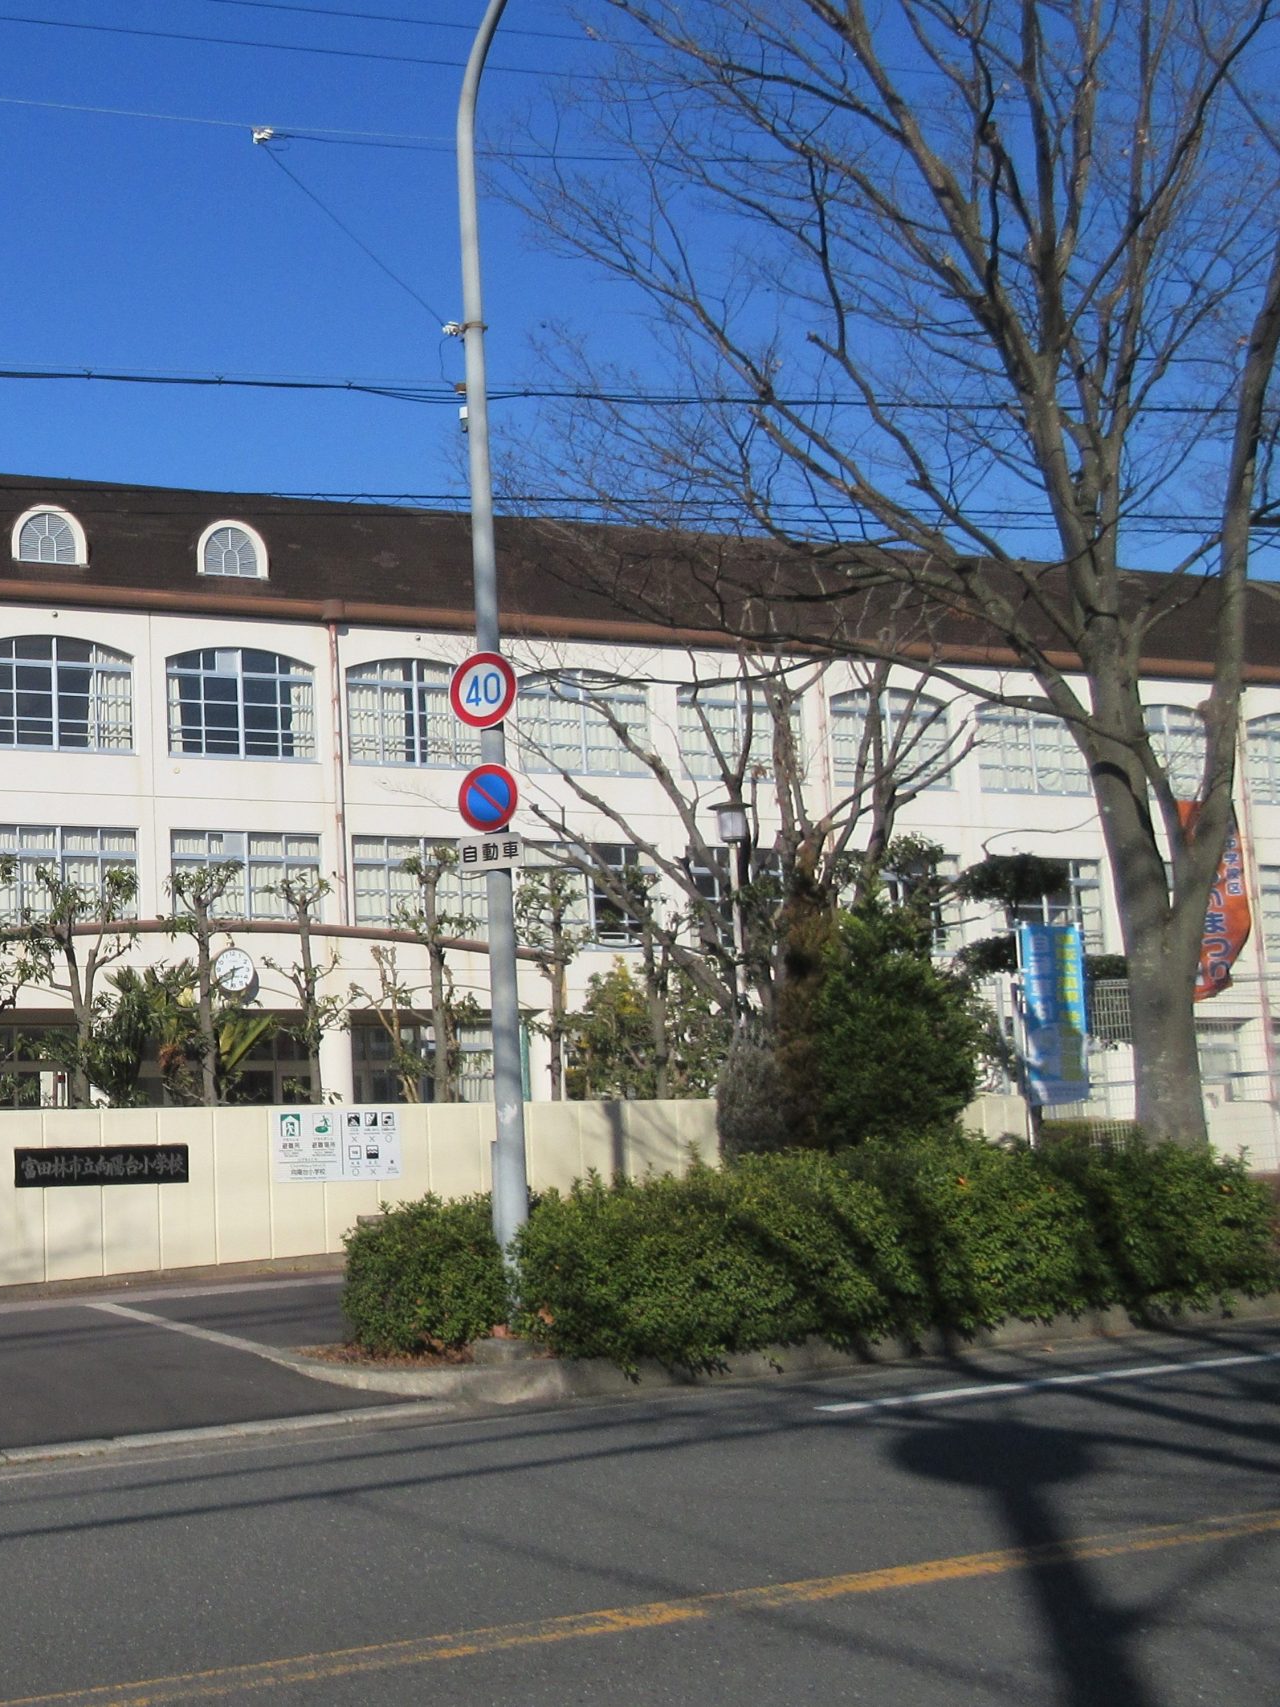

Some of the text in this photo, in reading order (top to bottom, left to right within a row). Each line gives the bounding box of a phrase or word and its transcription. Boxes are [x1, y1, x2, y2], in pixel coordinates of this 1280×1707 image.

[466, 672, 500, 706] 40
[463, 841, 519, 863] 自動車
[21, 1152, 187, 1180] 富田林市立向陽台小学校
